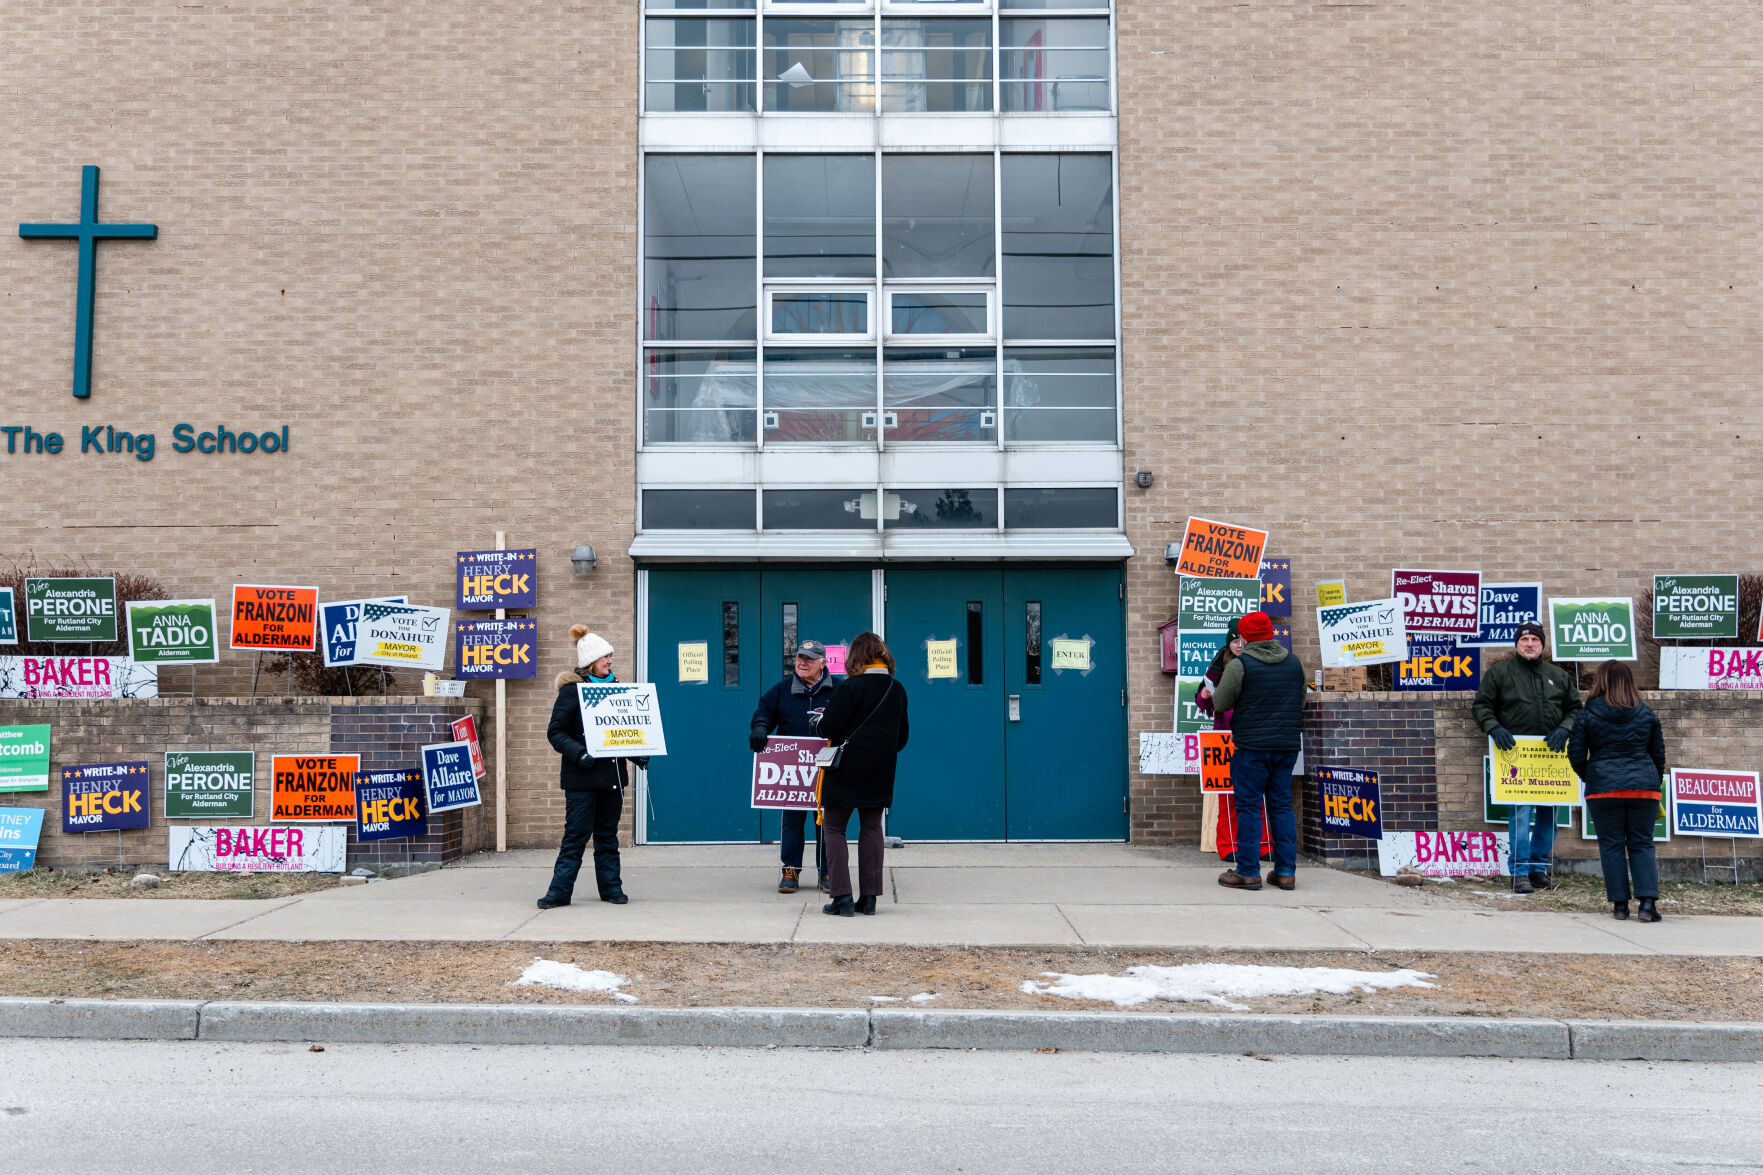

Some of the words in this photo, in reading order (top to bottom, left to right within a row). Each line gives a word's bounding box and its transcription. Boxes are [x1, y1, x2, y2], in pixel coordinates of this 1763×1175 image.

[0, 426, 64, 454] The
[81, 425, 155, 461] King
[172, 424, 288, 453] School
[1208, 524, 1246, 540] VOTE
[1186, 532, 1260, 564] FRANZONI
[476, 552, 517, 562] WRITE-IN
[1209, 557, 1230, 568] FOR
[464, 564, 512, 576] HENRY
[463, 574, 530, 596] HECK
[1181, 578, 1201, 592] Vote
[1396, 575, 1432, 586] Re-Elect
[1655, 576, 1676, 591] Vote
[27, 580, 50, 594] Vote
[1196, 588, 1242, 597] Alexandria
[1432, 581, 1476, 594] Sharon
[1672, 586, 1720, 595] Alexandria
[46, 589, 96, 598] Alexandria
[256, 590, 296, 600] VOTE
[463, 594, 493, 603] MAYOR
[1482, 589, 1519, 603] Dave
[30, 598, 114, 616] PERONE
[1181, 596, 1258, 614] PERONE
[1397, 592, 1476, 615] DAVIS
[1656, 595, 1735, 612] PERONE
[236, 602, 312, 623] FRANZONI
[1480, 604, 1534, 624] llaire
[1574, 612, 1611, 624] ANNA
[1710, 614, 1724, 623] City
[87, 618, 102, 626] City
[152, 614, 192, 627] ANNA
[392, 616, 418, 627] VOTE
[1349, 615, 1374, 624] VOTE
[1405, 616, 1476, 628] LDERMAN
[263, 624, 284, 632] FOR
[476, 622, 518, 631] WRITE-IN
[136, 625, 208, 646] TADIO
[234, 632, 311, 646] ALDERMAN
[370, 628, 434, 644] DONAHUE
[1332, 627, 1394, 642] DONAHUE
[1488, 628, 1516, 640] MAY
[1559, 623, 1626, 643] TADIO
[462, 634, 512, 645] HENRY
[384, 642, 416, 652] MAYOR
[1348, 641, 1378, 652] MAYOR
[332, 646, 352, 660] for
[462, 644, 530, 666] HECK
[1056, 650, 1085, 659] ENTER
[24, 658, 111, 686] BAKER
[462, 664, 493, 673] MAYOR
[1182, 666, 1199, 674] FOR
[1400, 656, 1473, 678] HECK
[1400, 677, 1433, 686] MAYOR
[608, 698, 632, 707] VOTE
[594, 716, 652, 726] DONAHUE
[610, 730, 640, 738] MAYOR
[759, 742, 798, 754] e-Elect
[166, 754, 189, 768] Vote
[436, 750, 460, 764] Dave
[184, 764, 234, 772] Alexandria
[296, 758, 336, 770] VOTE
[84, 766, 128, 777] WRITE-IN
[430, 766, 472, 788] Allaire
[758, 762, 818, 786] DAV
[1332, 770, 1364, 783] WRITE-IN
[168, 773, 251, 790] PERONE
[370, 773, 406, 784] WRITE-IN
[1528, 778, 1572, 786] Museum
[69, 780, 122, 794] HENRY
[1323, 782, 1360, 798] HENRY
[1678, 778, 1754, 798] BEAUCHAMP
[224, 792, 238, 801] City
[304, 794, 326, 802] FOR
[360, 786, 402, 801] HENRY
[434, 792, 444, 806] for
[448, 787, 476, 802] MAYOR
[756, 790, 818, 802] ALDERM
[69, 790, 142, 817] HECK
[1324, 794, 1376, 823] HECK
[1712, 805, 1724, 814] for
[274, 804, 354, 816] ALDERMAN
[361, 796, 420, 824] HECK
[69, 814, 102, 824] MAYOR
[1325, 816, 1350, 827] MAYOR
[1680, 813, 1757, 831] ALDERMAN
[362, 822, 390, 832] MAYOR
[216, 828, 304, 857] BAKER
[1415, 832, 1500, 862] BAKER
